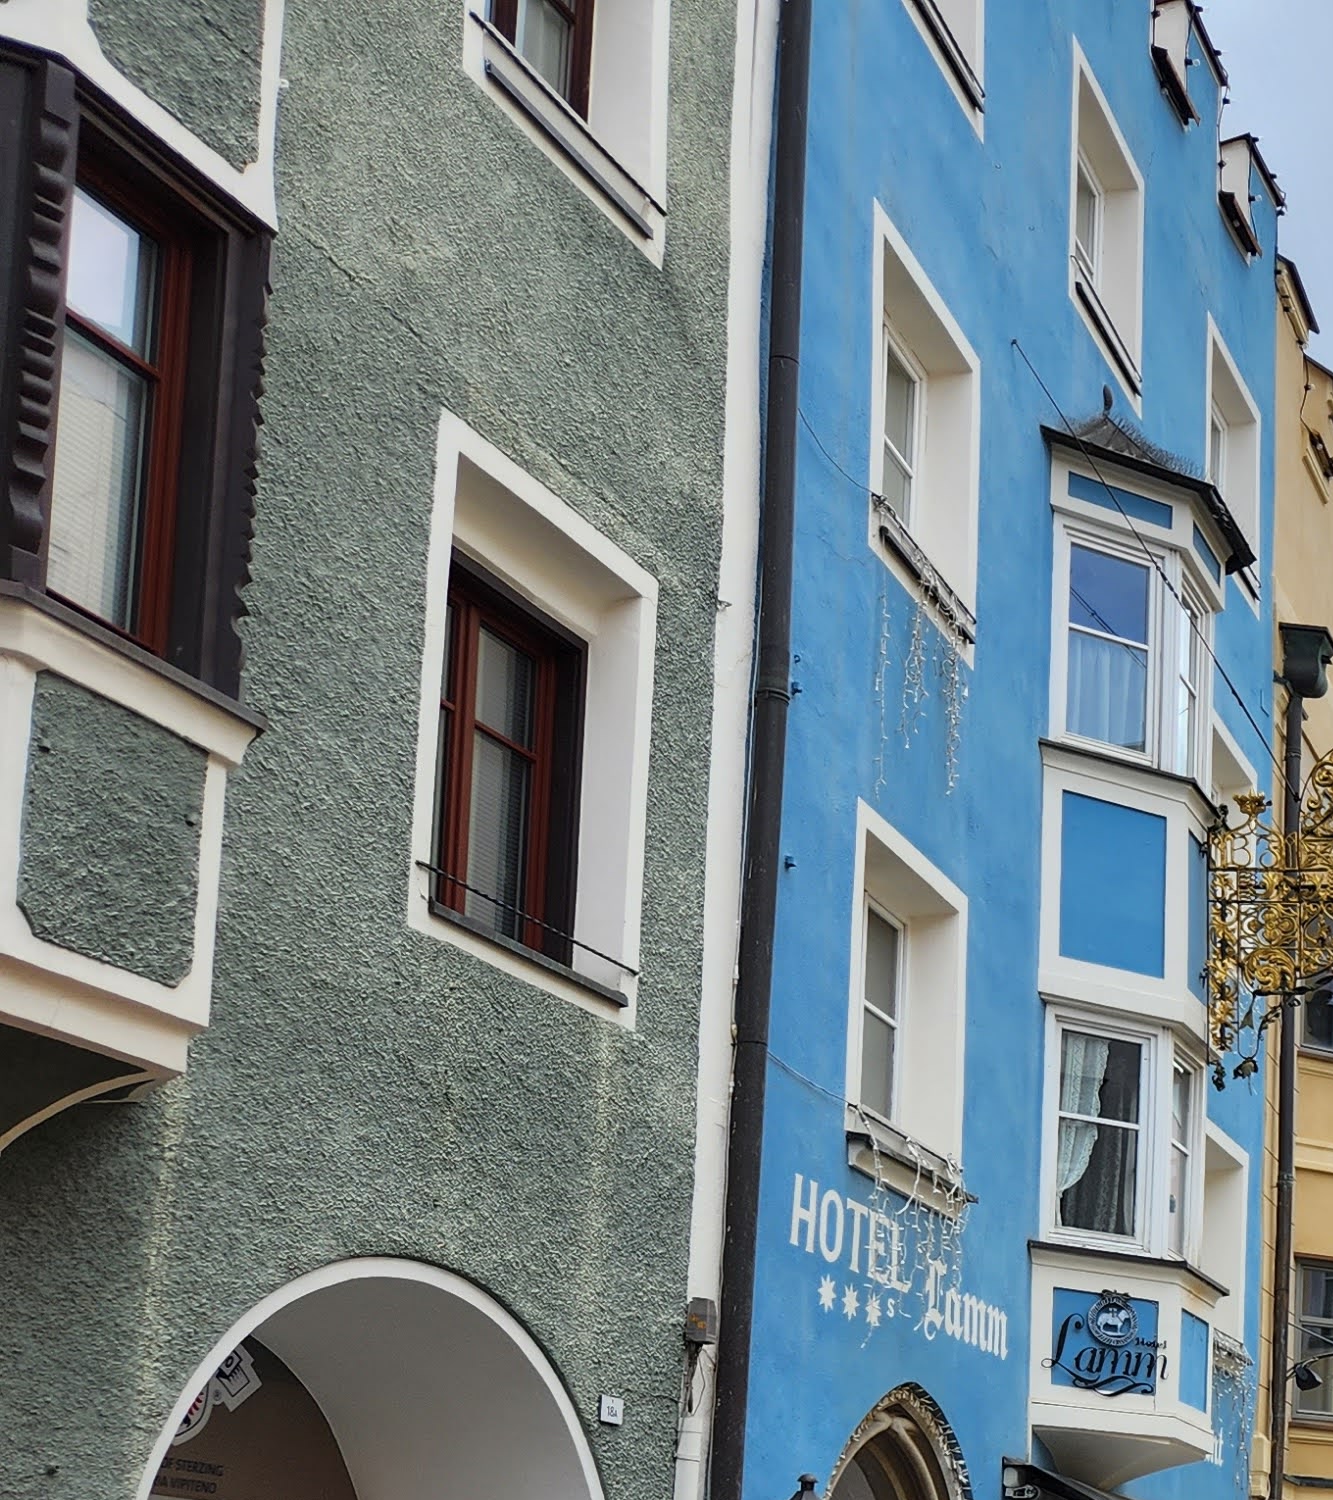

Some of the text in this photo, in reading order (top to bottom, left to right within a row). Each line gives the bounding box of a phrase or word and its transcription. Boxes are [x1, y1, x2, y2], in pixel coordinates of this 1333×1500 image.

[789, 1172, 912, 1293] HOTEL
[923, 1256, 1008, 1361] Lamm
[1041, 1313, 1169, 1396] Lamm
